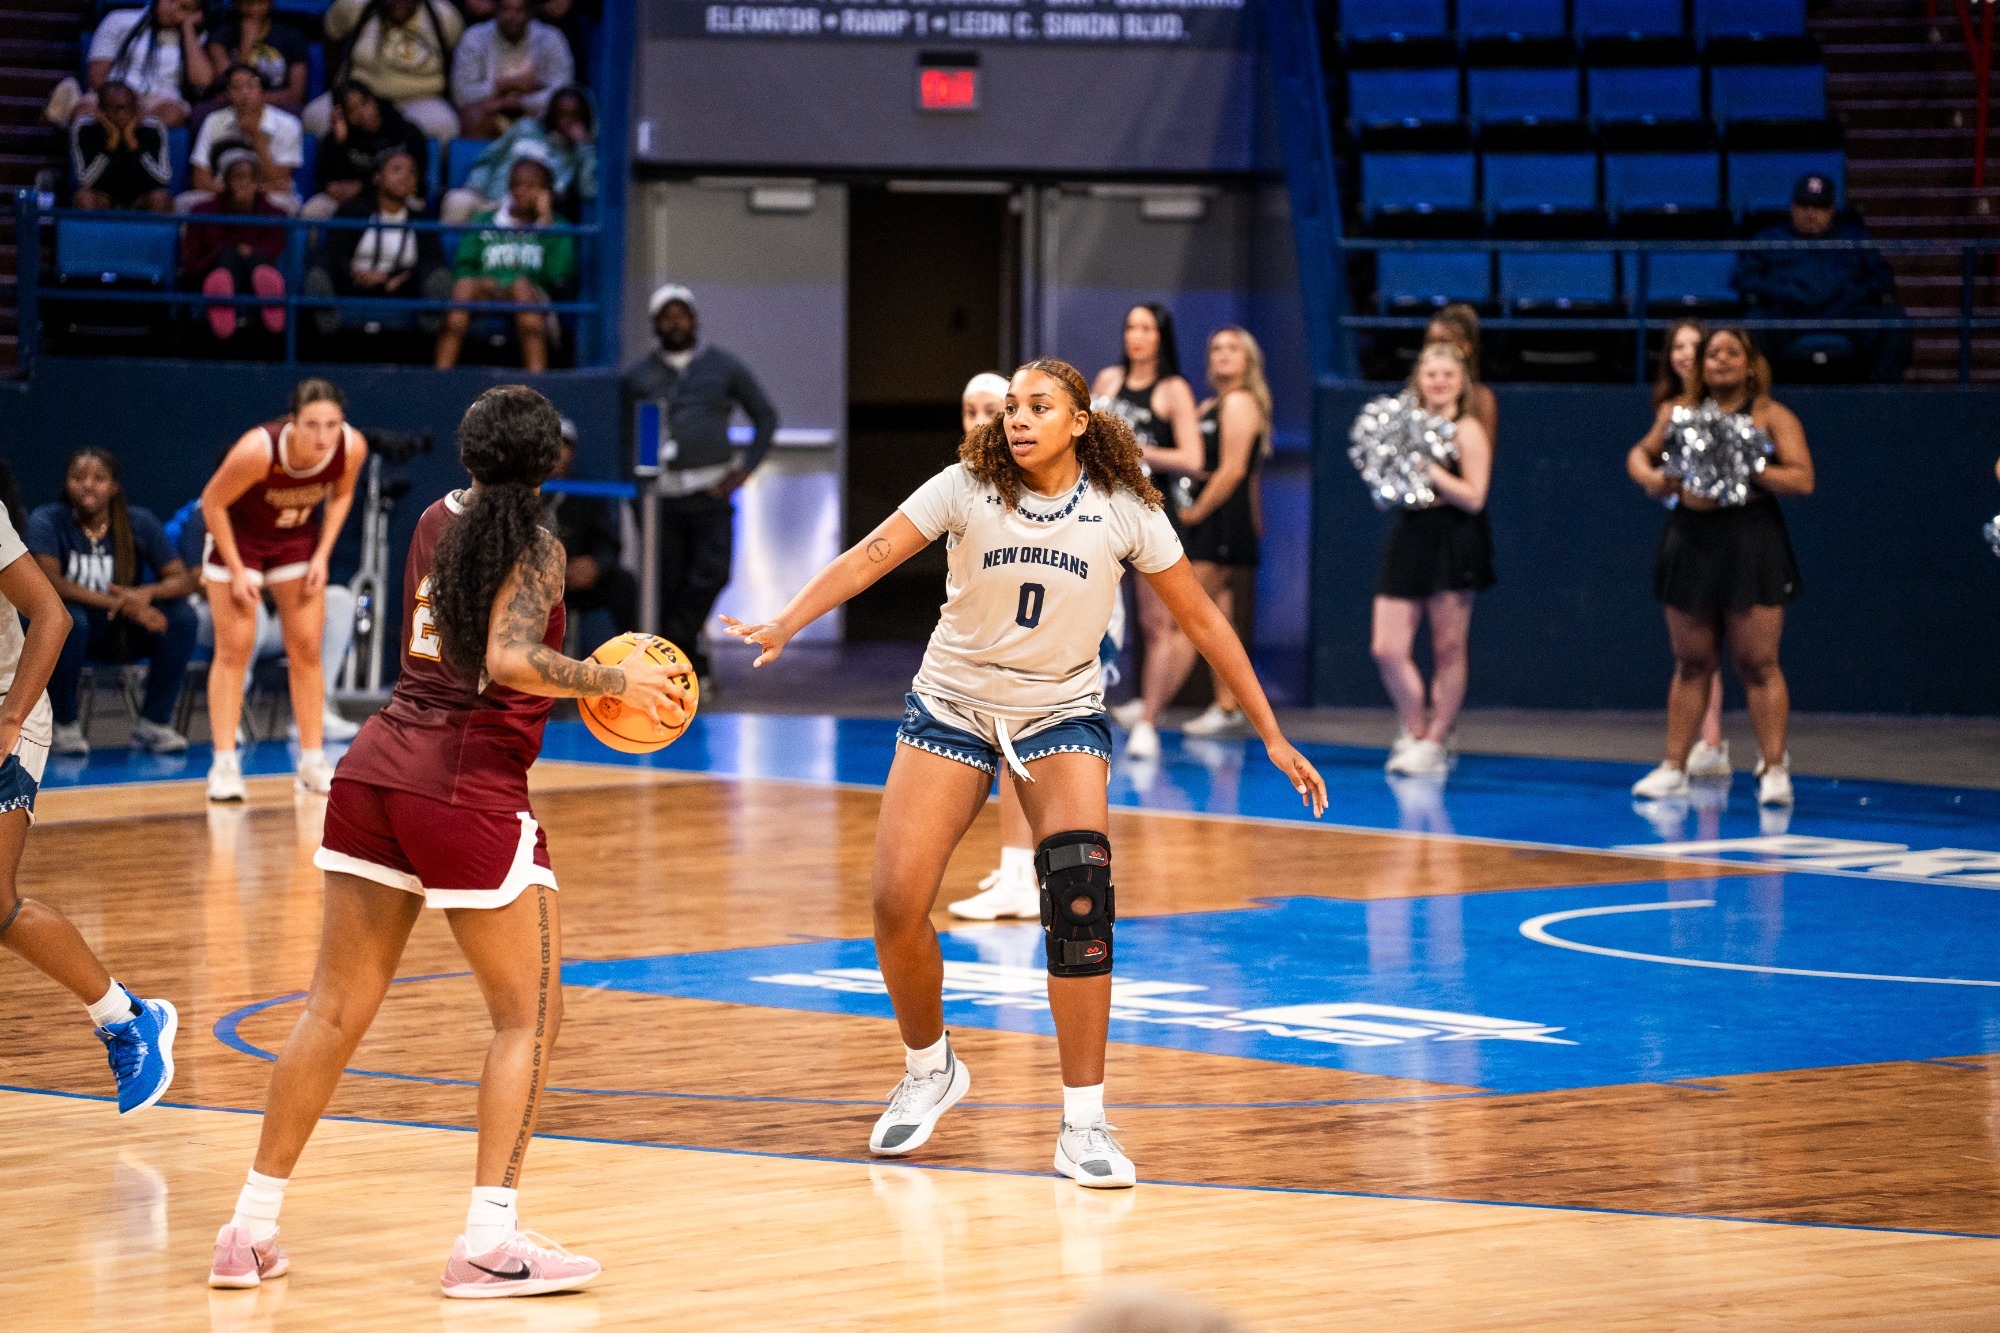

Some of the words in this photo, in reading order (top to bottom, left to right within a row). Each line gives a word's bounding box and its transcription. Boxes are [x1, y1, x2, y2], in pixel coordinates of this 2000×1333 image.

[705, 5, 821, 34] ELEVATOR
[840, 8, 911, 36] RAMP
[949, 9, 1011, 38] LEON
[1042, 11, 1121, 40] SIMON
[983, 546, 1018, 570] NEW
[1020, 546, 1089, 580] ORLEANS
[1015, 582, 1046, 629] 0
[538, 896, 550, 964] CONQUERED
[540, 966, 550, 990] HER
[535, 992, 547, 1038] DEMONS
[533, 1042, 542, 1066] AND
[528, 1069, 539, 1103] WORE
[522, 1104, 534, 1128] HER
[509, 1130, 526, 1164] SCARS
